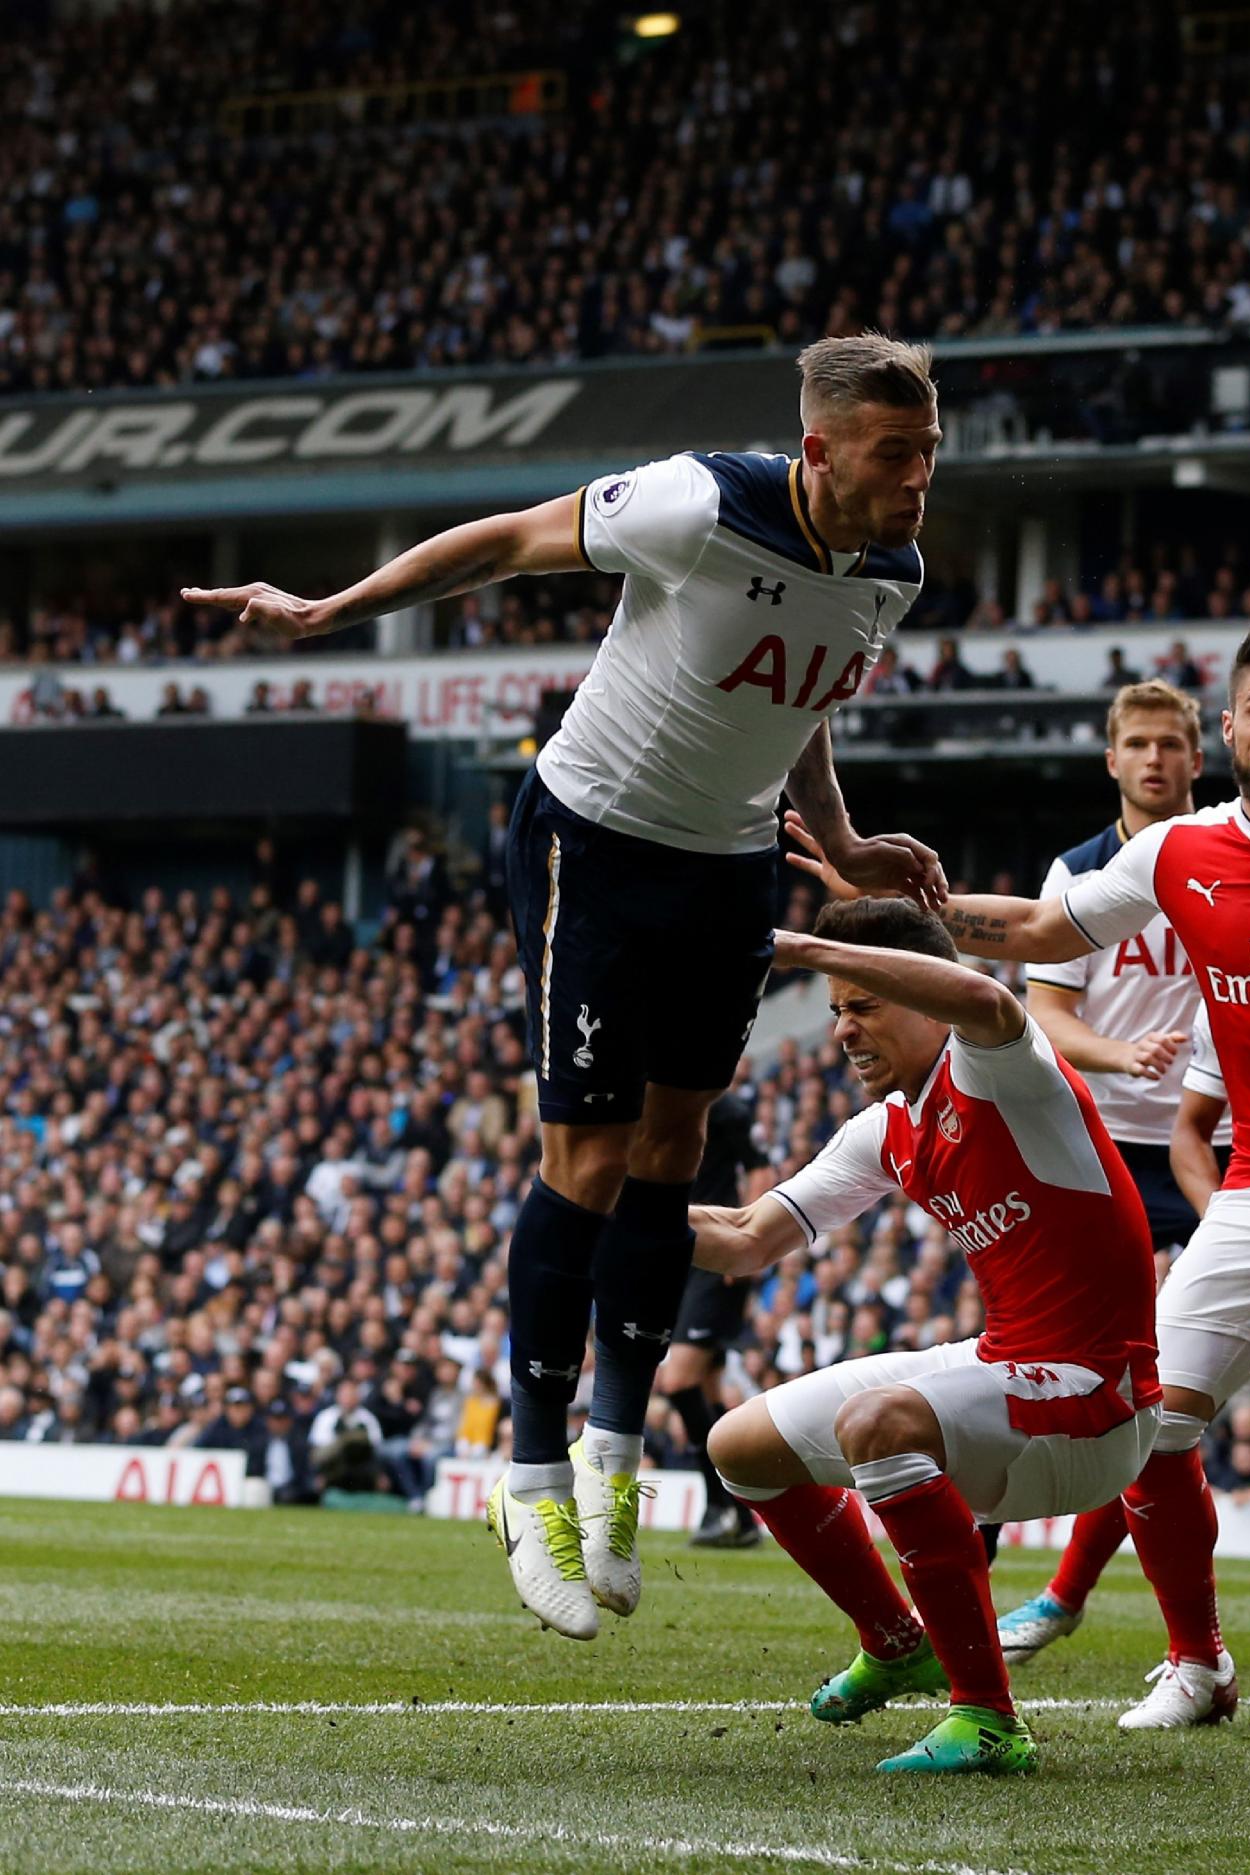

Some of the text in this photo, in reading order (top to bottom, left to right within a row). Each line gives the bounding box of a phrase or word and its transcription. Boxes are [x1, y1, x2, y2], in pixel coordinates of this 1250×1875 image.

[714, 634, 866, 712] AIA
[1112, 927, 1193, 977] AI
[114, 1457, 226, 1504] AIA
